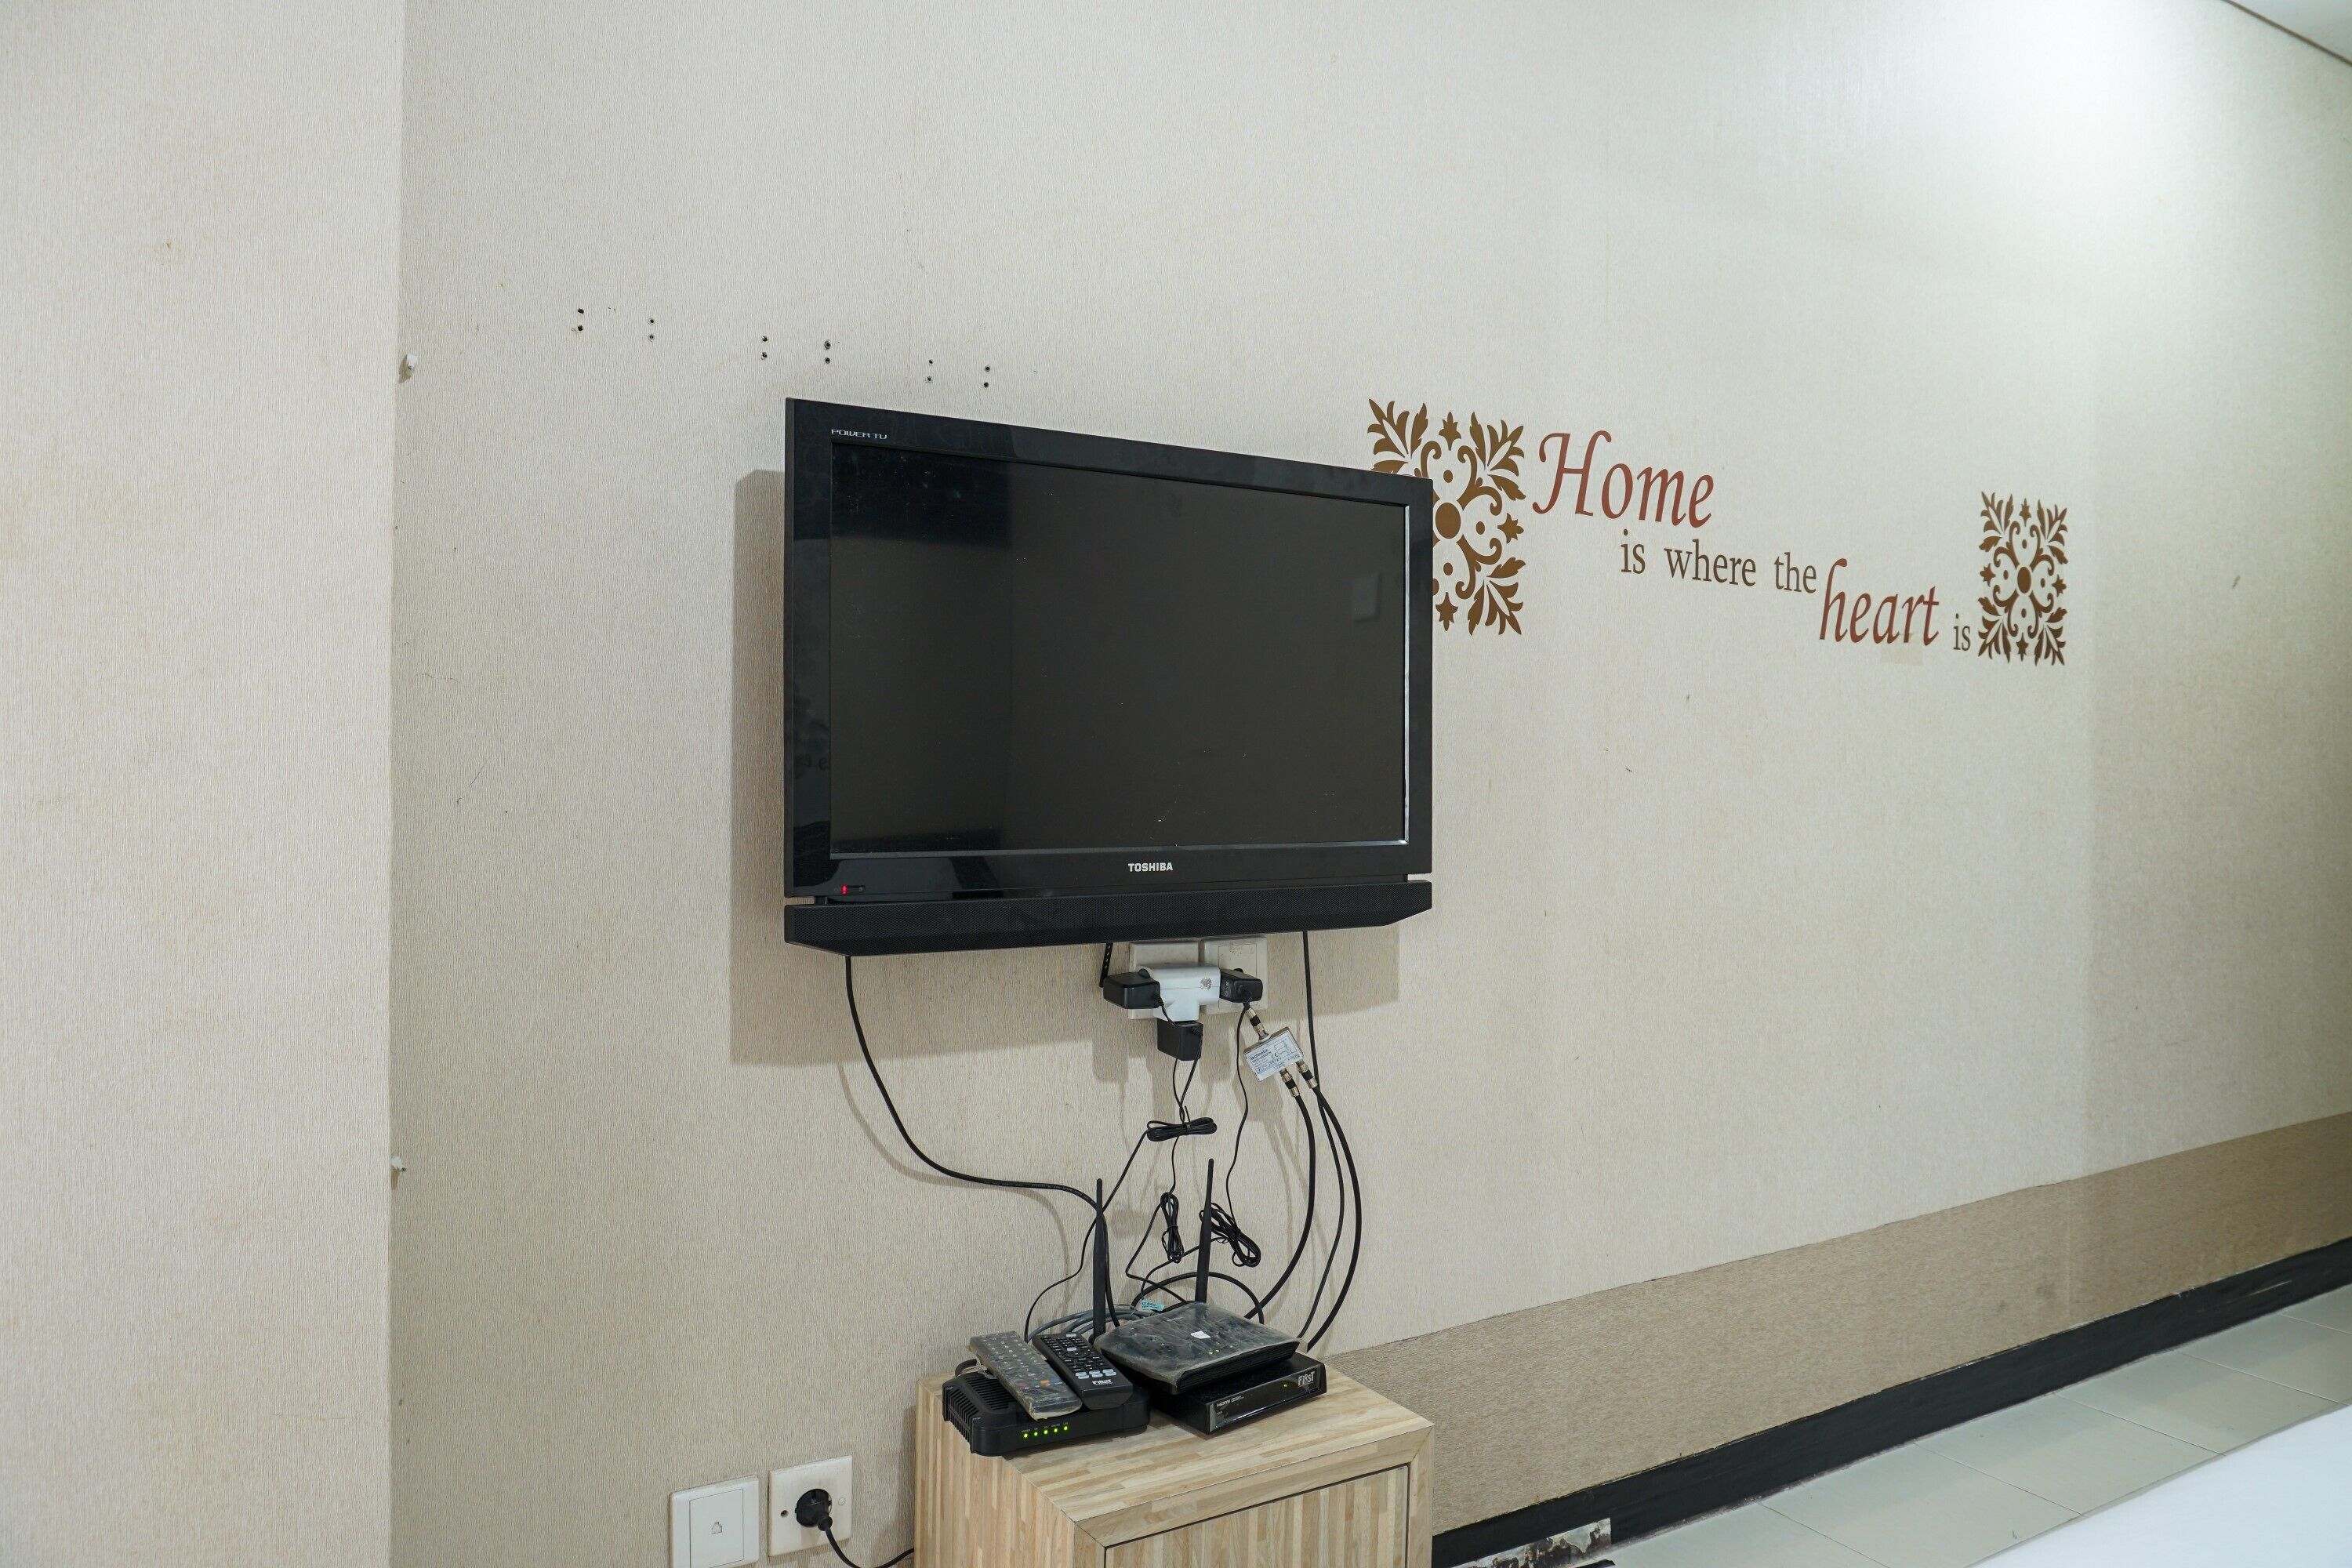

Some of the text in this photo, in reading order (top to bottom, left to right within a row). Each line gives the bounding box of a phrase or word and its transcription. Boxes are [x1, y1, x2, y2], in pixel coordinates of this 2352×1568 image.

[831, 429, 870, 438] POWER
[1532, 430, 1714, 528] Home
[1621, 529, 1818, 595] is where the
[1819, 557, 1971, 652] heart is
[1127, 862, 1174, 873] TOSHIBA
[1298, 1371, 1316, 1387] FIRST
